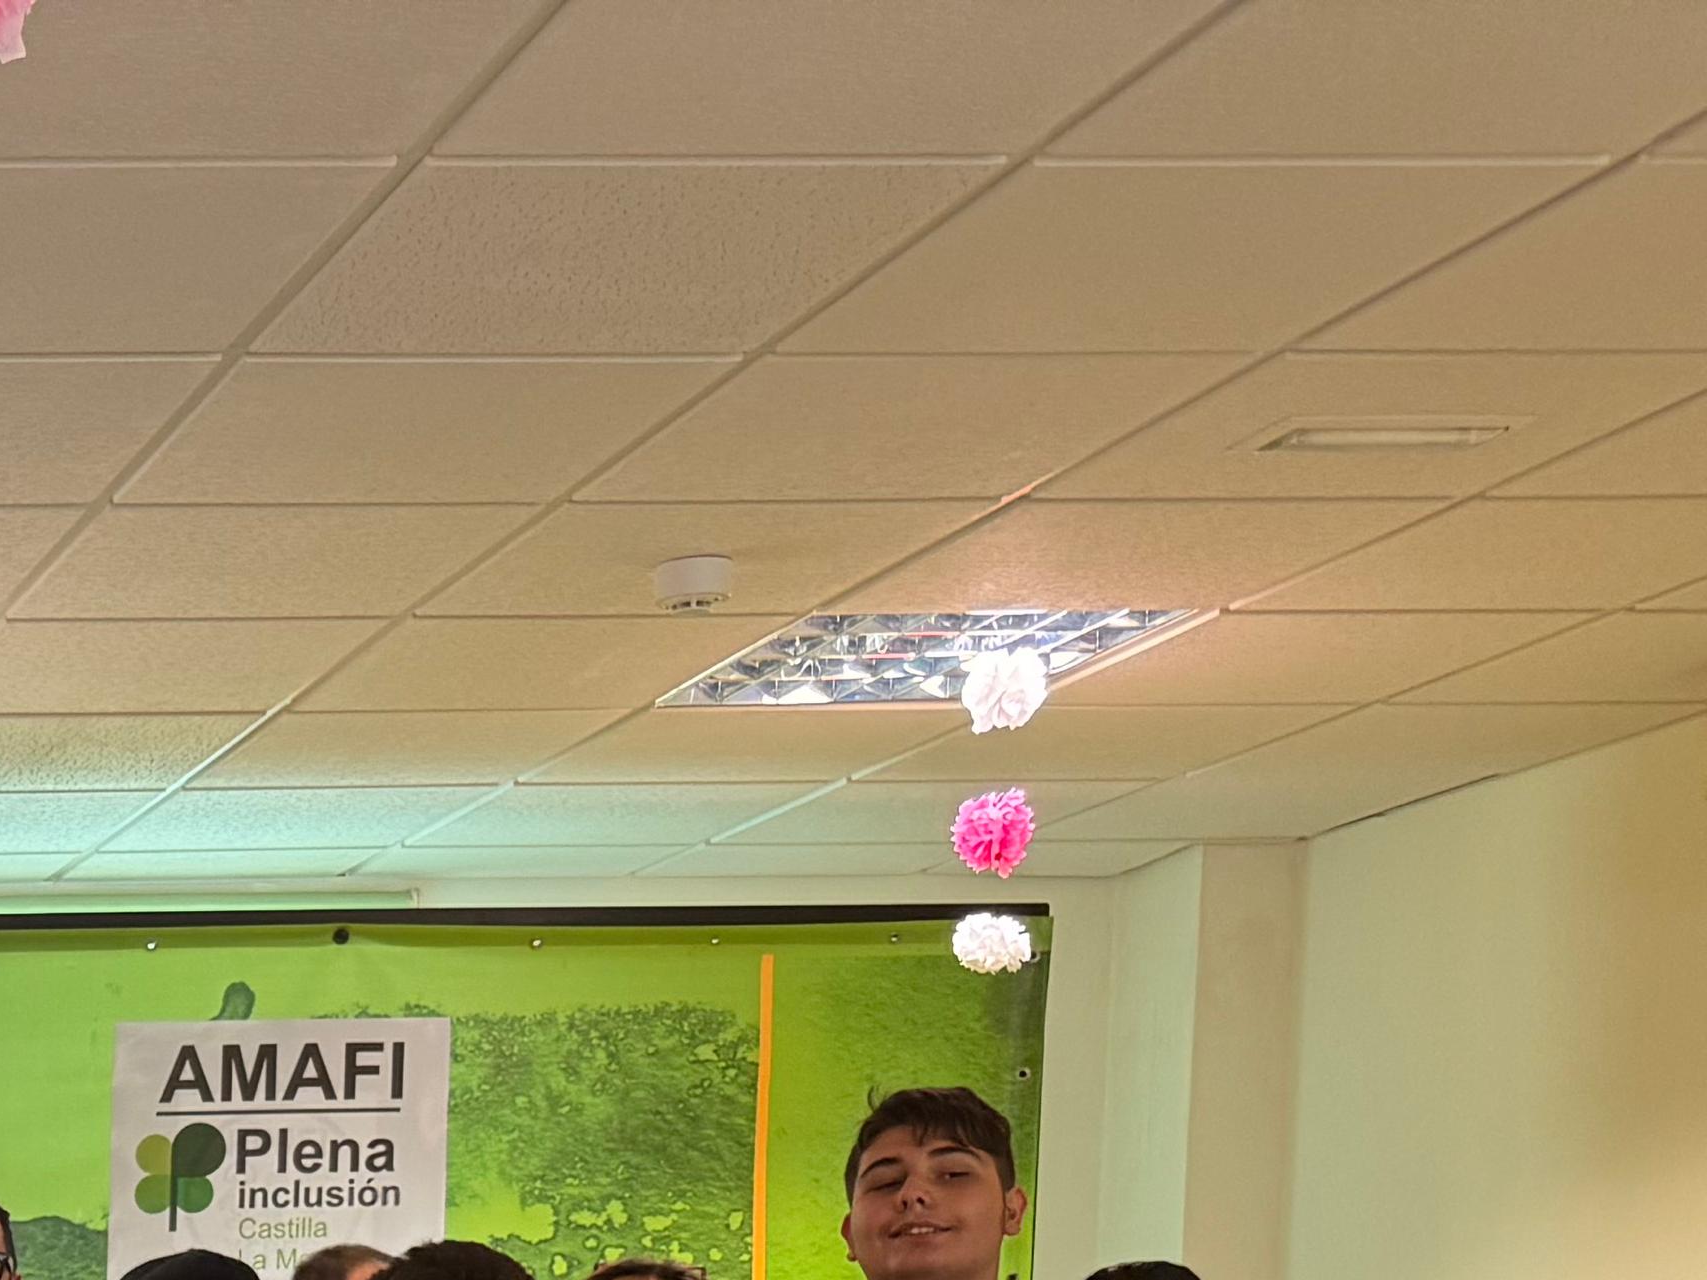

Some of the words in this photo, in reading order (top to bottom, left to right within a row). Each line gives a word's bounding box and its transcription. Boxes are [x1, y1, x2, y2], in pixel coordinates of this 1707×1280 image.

[159, 1042, 405, 1104] AMAFI
[235, 1128, 395, 1175] Plena
[237, 1178, 401, 1209] inclusión
[238, 1216, 328, 1240] Castilla
